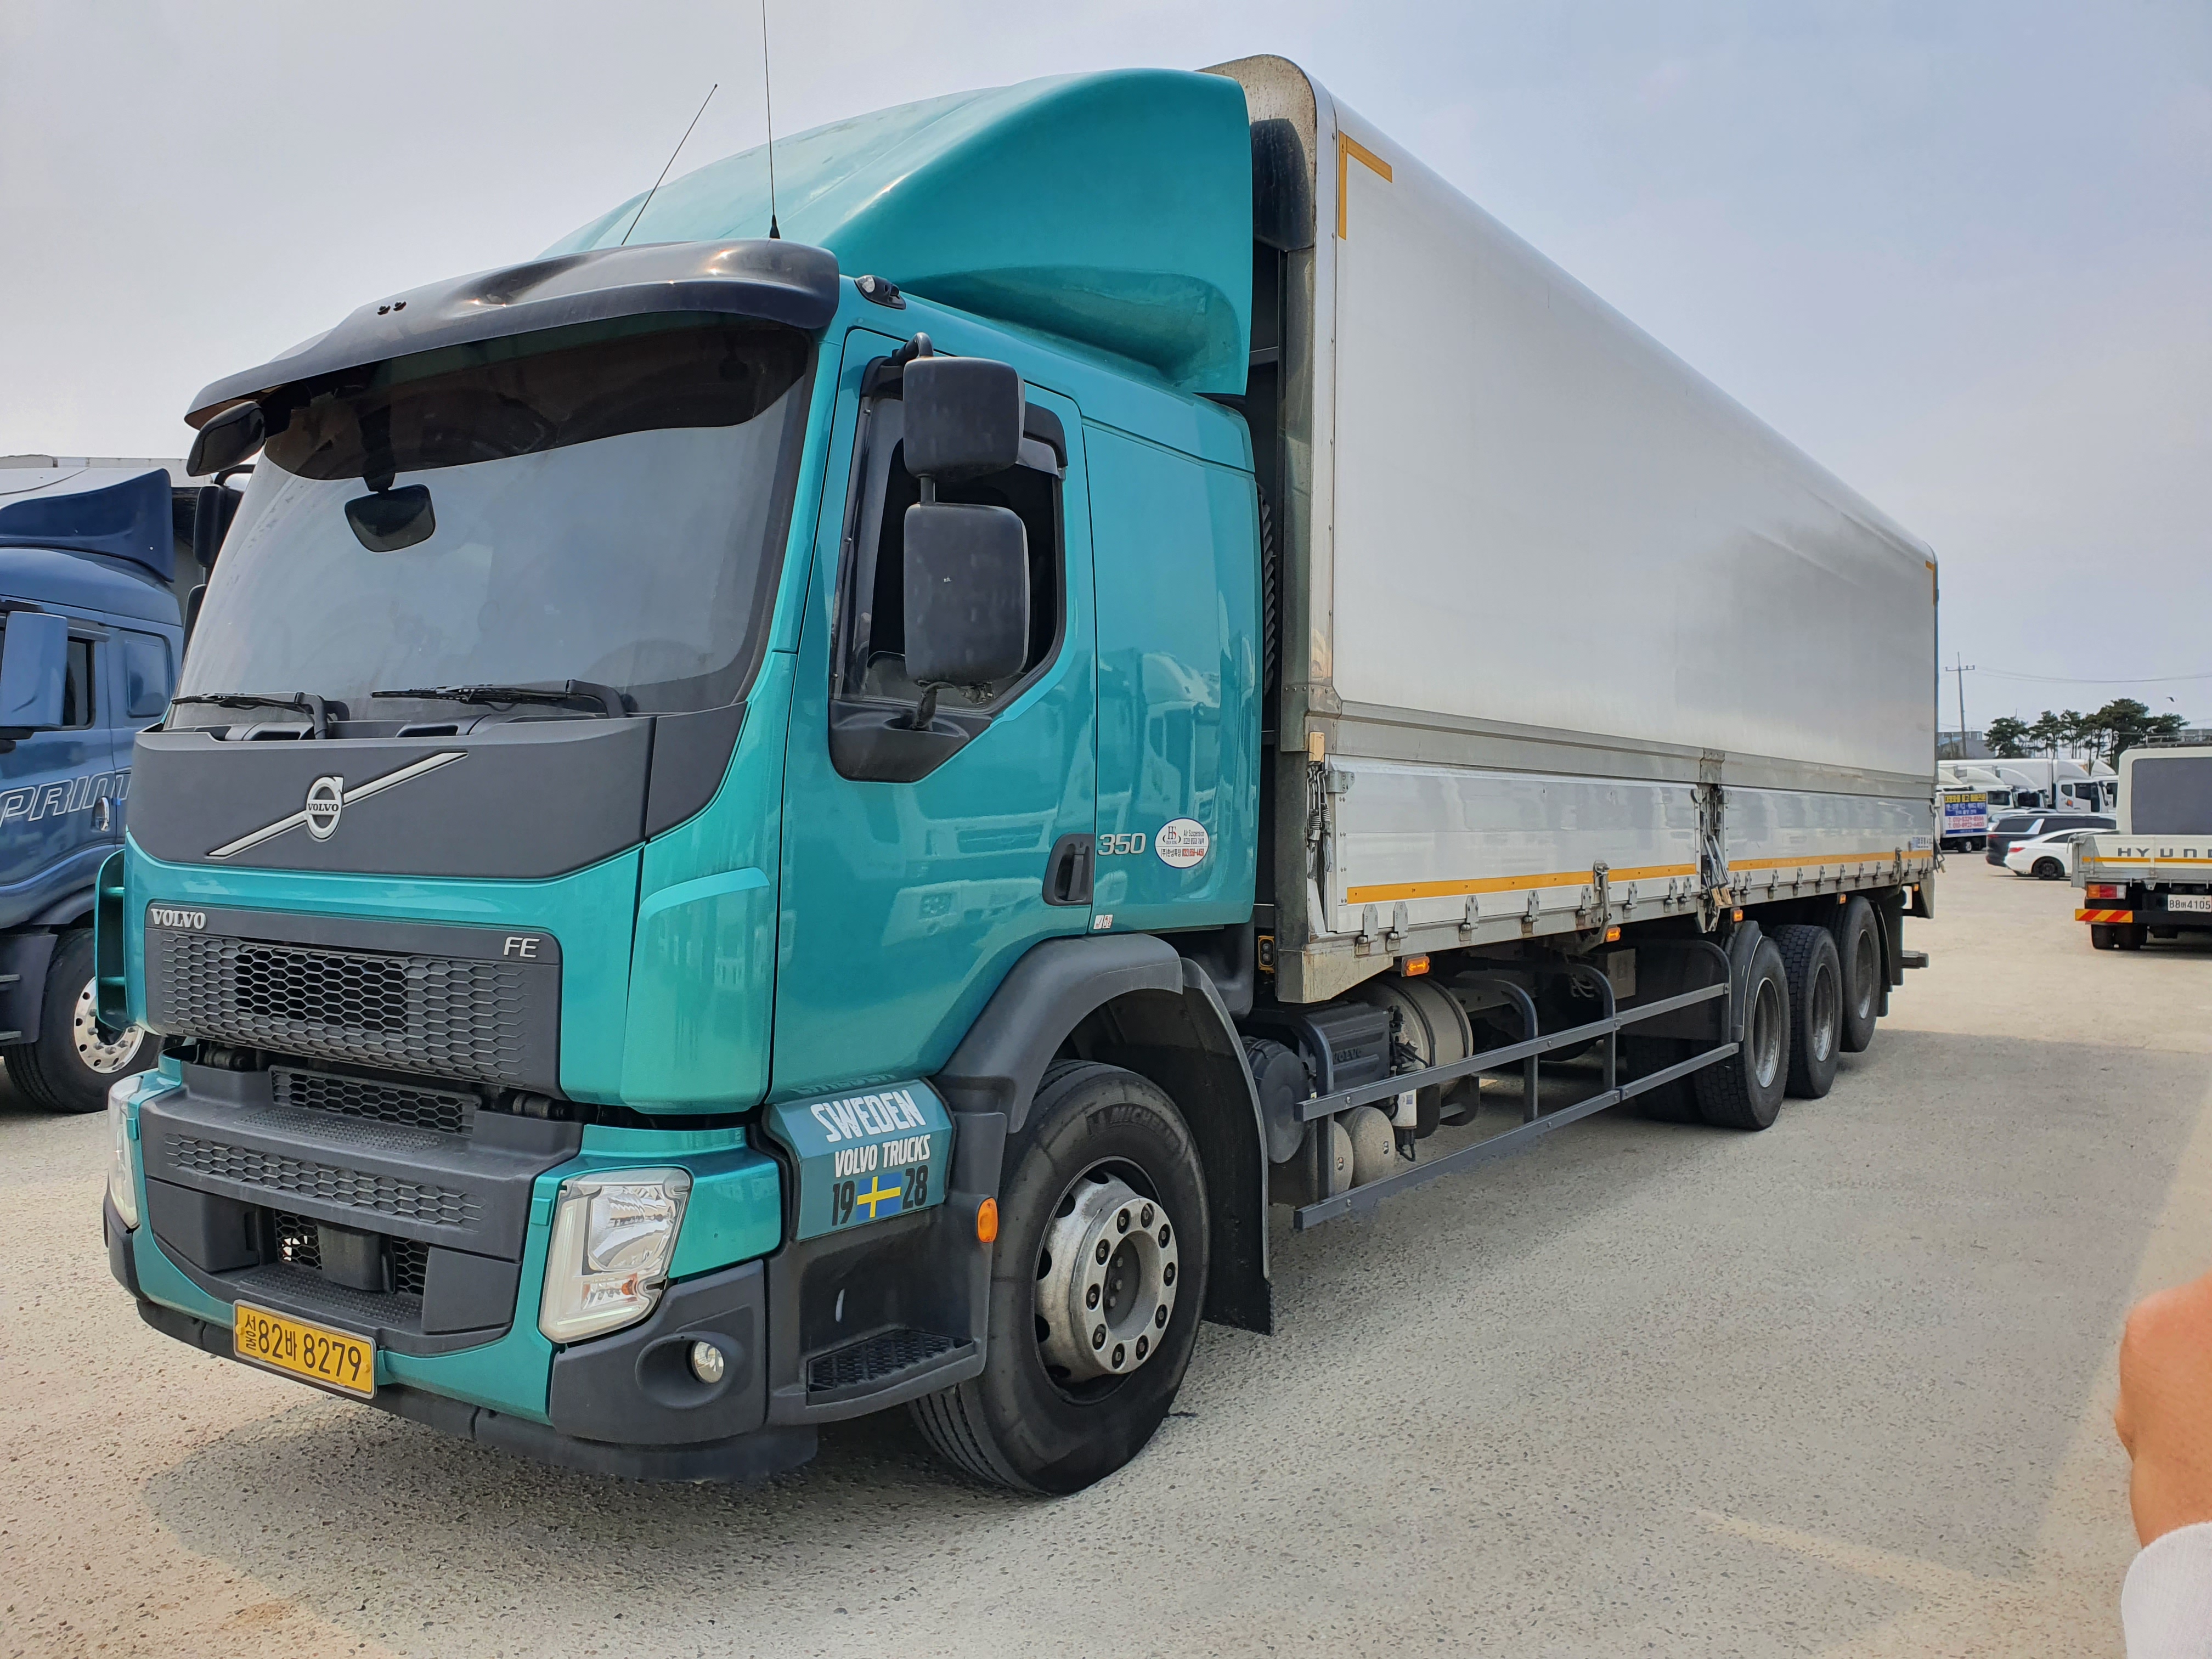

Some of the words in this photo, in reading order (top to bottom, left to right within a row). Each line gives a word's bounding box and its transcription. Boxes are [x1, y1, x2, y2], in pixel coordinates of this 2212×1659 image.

[308, 803, 339, 812] VOLVO
[1098, 833, 1146, 855] 350
[150, 908, 206, 929] VOLVO
[504, 936, 540, 958] FE
[810, 1090, 926, 1142] SWEDEN
[834, 1144, 878, 1178] VOLVO
[882, 1133, 932, 1168] TRUCKS
[831, 1180, 855, 1226] 19
[901, 1165, 928, 1210] 28
[303, 1334, 362, 1381] 8279
